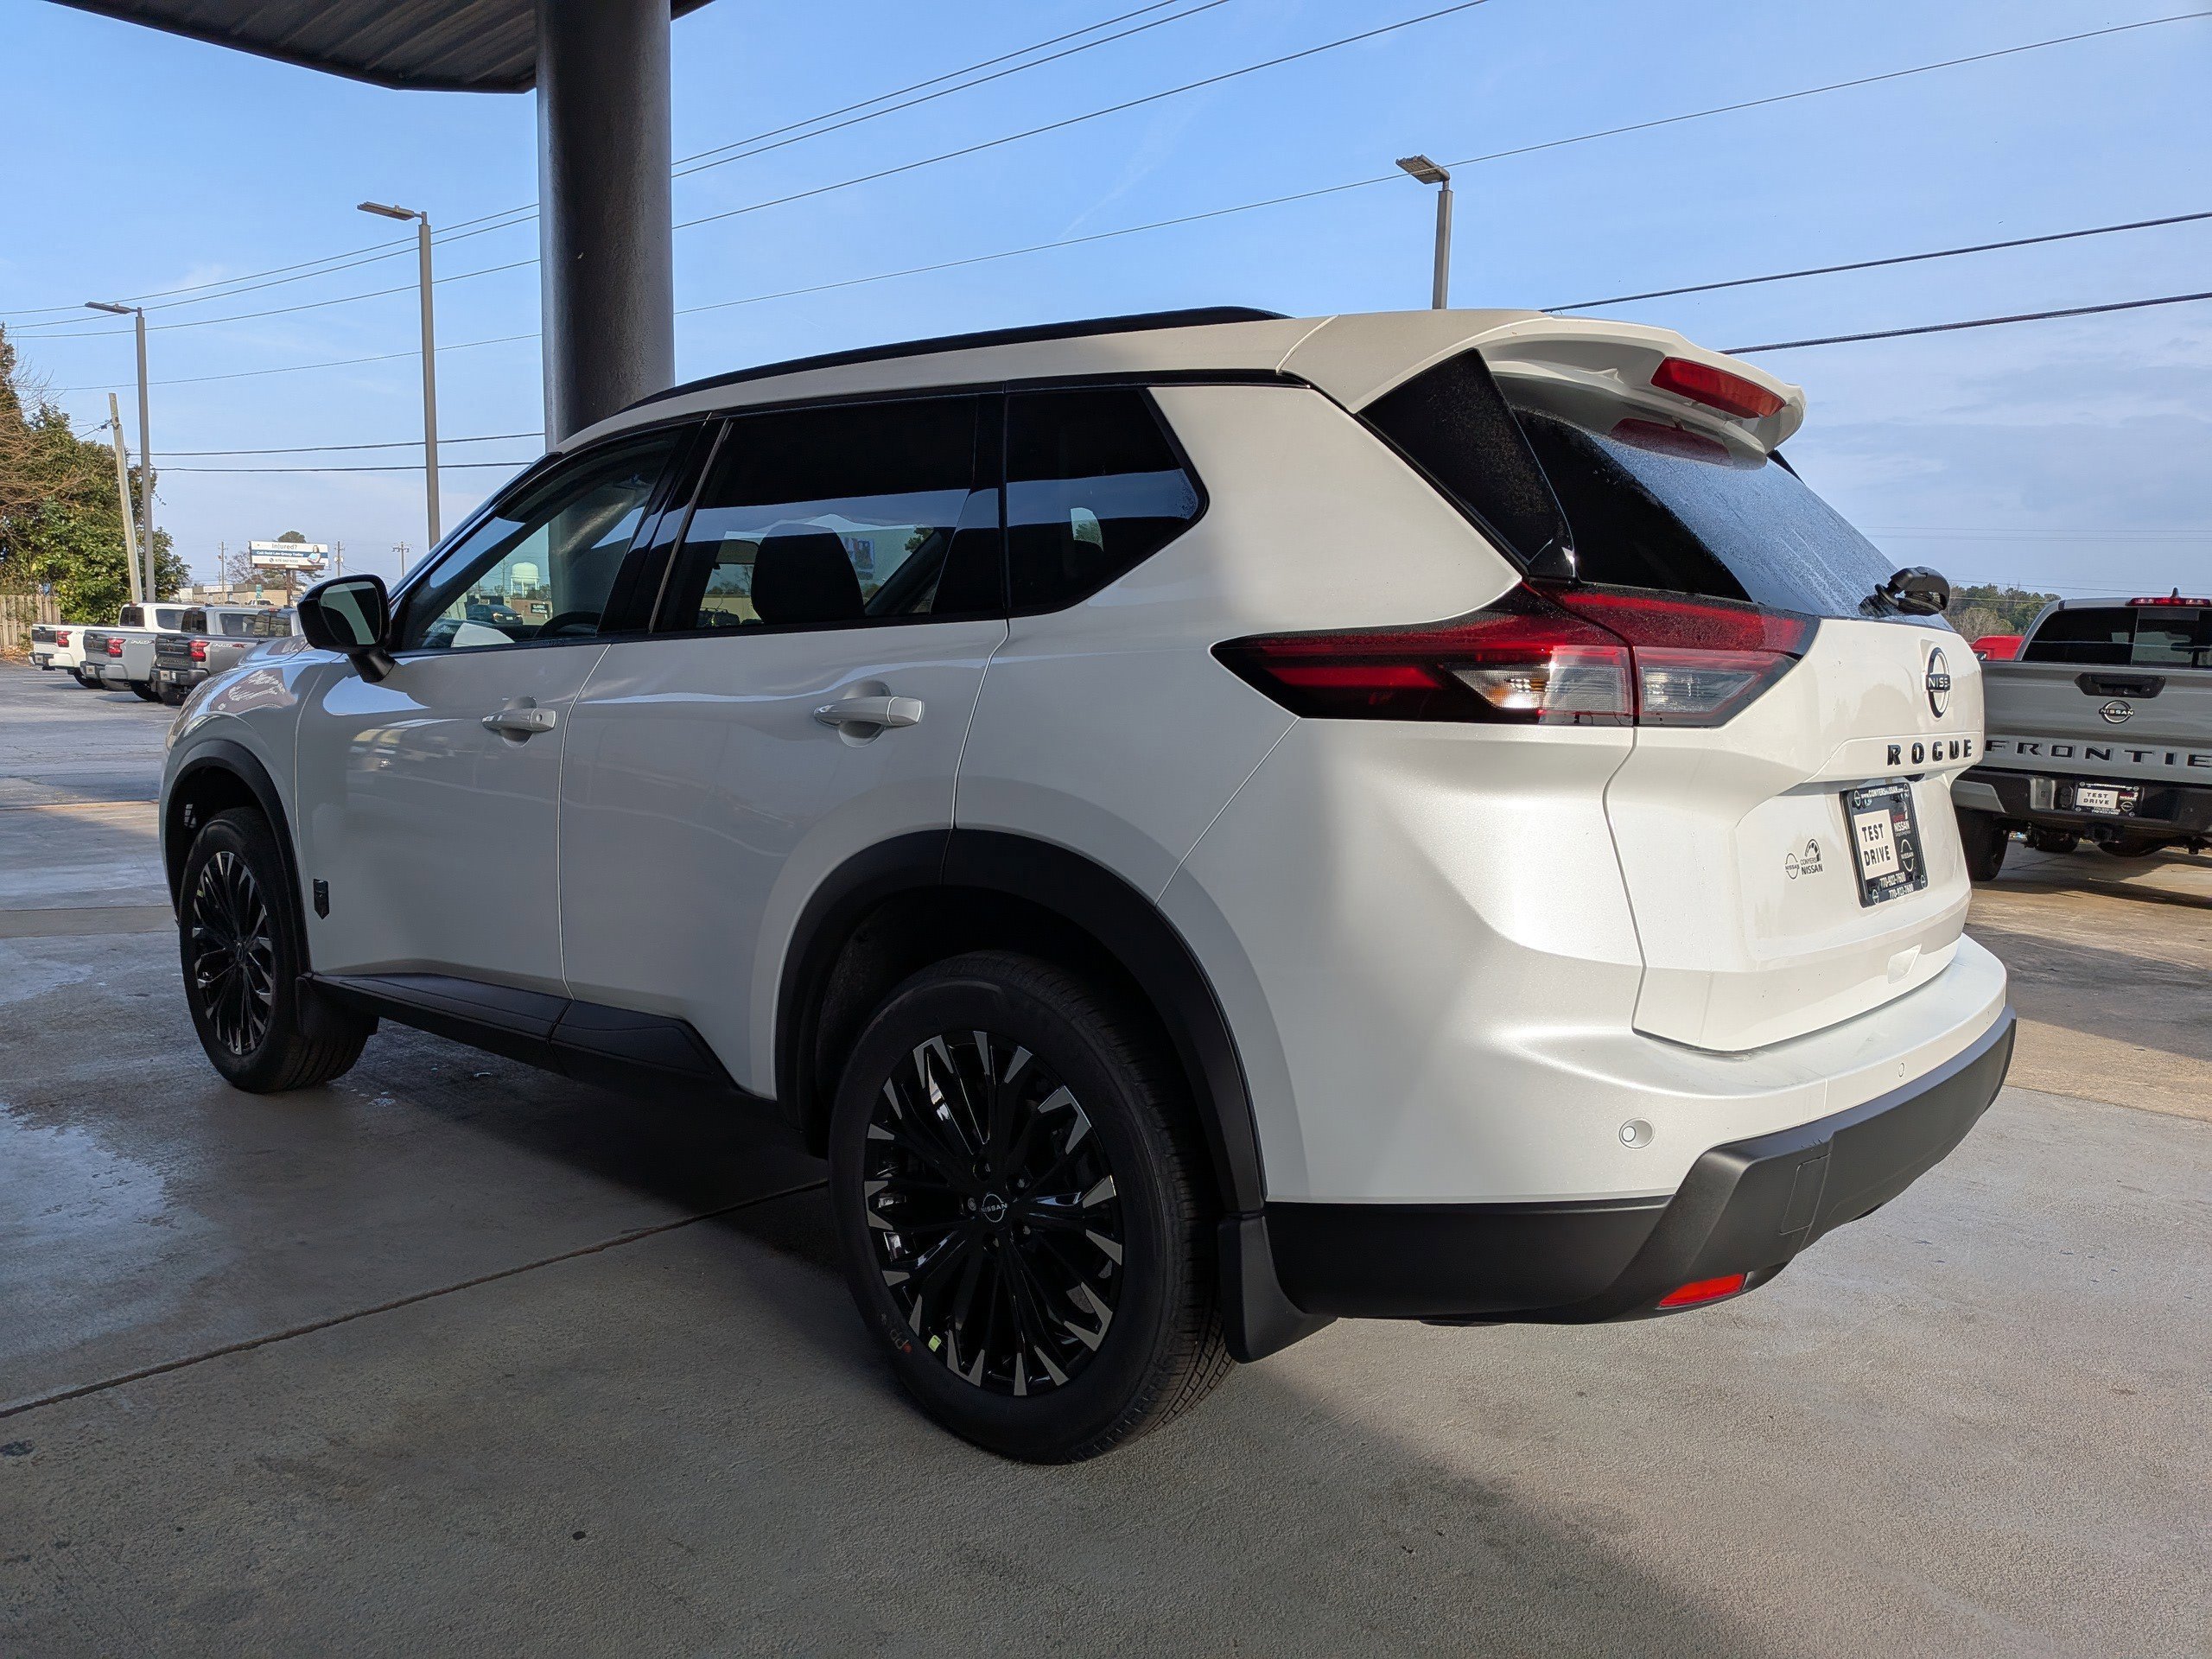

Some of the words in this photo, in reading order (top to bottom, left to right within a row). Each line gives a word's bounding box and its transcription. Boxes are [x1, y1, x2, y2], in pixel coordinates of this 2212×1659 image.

[1886, 739, 1973, 766] ROGUE
[1861, 823, 1884, 842] TEST
[1893, 820, 1910, 832] NISSAN
[1800, 857, 1817, 866] CONYERS
[1864, 845, 1891, 866] DRIVE
[1801, 864, 1823, 875] NISSAN
